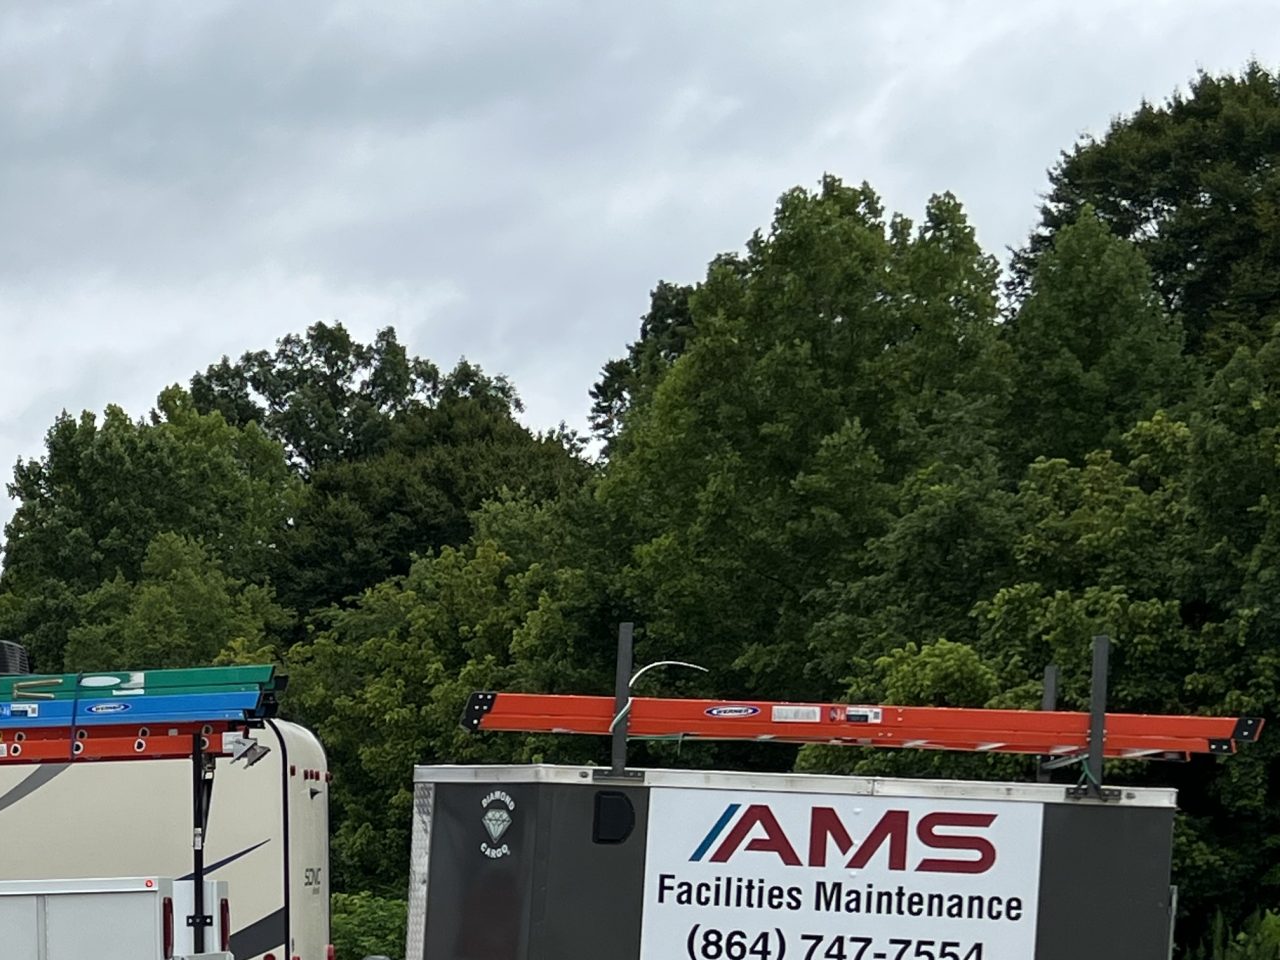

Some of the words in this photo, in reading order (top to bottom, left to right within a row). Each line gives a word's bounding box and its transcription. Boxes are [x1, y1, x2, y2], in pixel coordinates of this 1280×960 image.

[481, 790, 515, 811] DIAMOND
[480, 842, 508, 859] CARGO
[708, 804, 999, 874] AMS
[657, 874, 802, 911] Facilities
[814, 881, 1022, 921] Maintenance
